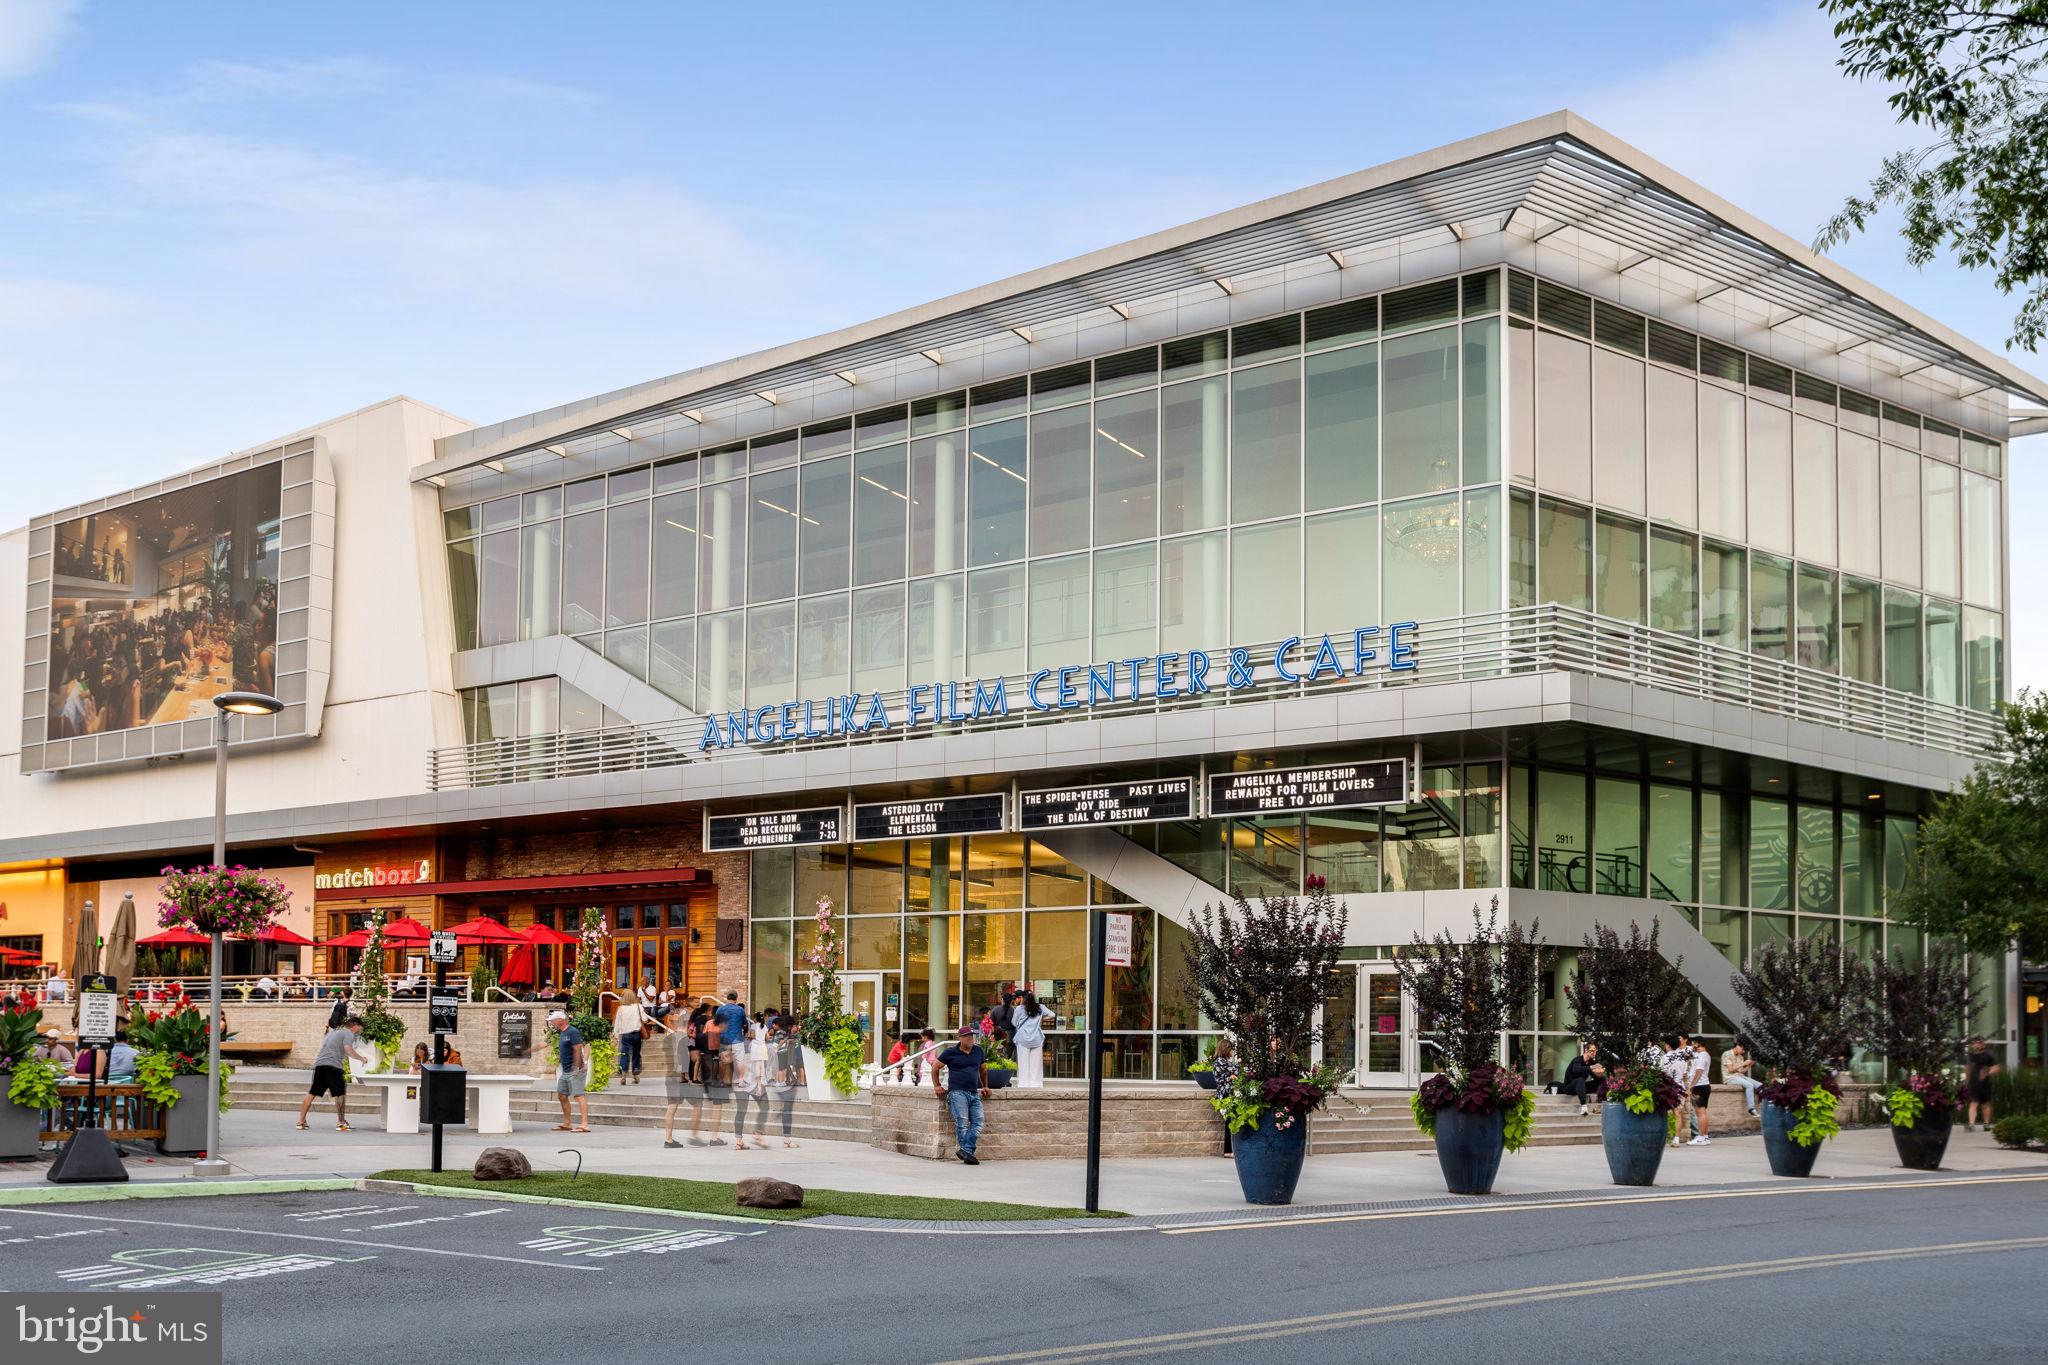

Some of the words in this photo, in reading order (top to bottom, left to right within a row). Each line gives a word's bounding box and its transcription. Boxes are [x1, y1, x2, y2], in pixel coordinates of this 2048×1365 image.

[700, 691, 890, 750] ANGELIKA
[907, 676, 1009, 727] FILM
[1028, 649, 1210, 711] CENTER
[1226, 647, 1255, 689] &
[1274, 621, 1418, 681] CAFE
[1233, 773, 1282, 788] ANGELIKA
[1288, 768, 1356, 783] MEMBERSHIP
[1129, 785, 1153, 796] PAST
[1158, 782, 1187, 794] LIVES
[1225, 787, 1272, 799] REWARDS
[1277, 784, 1297, 796] FOR
[1302, 782, 1327, 794] FILM
[1333, 778, 1375, 791] LOVERS
[1025, 795, 1041, 805] THE
[1045, 789, 1110, 803] SPIDER-VERSE
[1259, 797, 1284, 808] FREE
[1291, 795, 1304, 806] TO
[1309, 793, 1334, 805] JOIN
[882, 804, 921, 816] ASTEROID
[924, 802, 944, 812] CITY
[1075, 801, 1094, 812] JOY
[1099, 799, 1120, 810] RIDE
[747, 817, 757, 826] ON
[760, 816, 778, 825] SALE
[781, 814, 798, 824] NOW
[890, 813, 936, 825] ELEMENTAL
[1047, 813, 1064, 824] THE
[1068, 811, 1089, 823] DIAL
[1094, 810, 1106, 820] OF
[1110, 807, 1150, 820] DESTINY
[740, 827, 758, 836] DEAD
[761, 823, 801, 834] RECKONING
[820, 821, 836, 830] 7-13
[888, 826, 903, 836] THE
[907, 823, 937, 834] LESSON
[743, 834, 793, 845] OPPENHEIMER
[819, 831, 837, 840] 7-20
[1556, 834, 1573, 844] 2911
[316, 867, 411, 889] matchbox
[1110, 923, 1127, 931] PARKING
[1108, 935, 1127, 943] STANDING
[1105, 945, 1116, 954] FIRE
[1117, 946, 1130, 954] LANE
